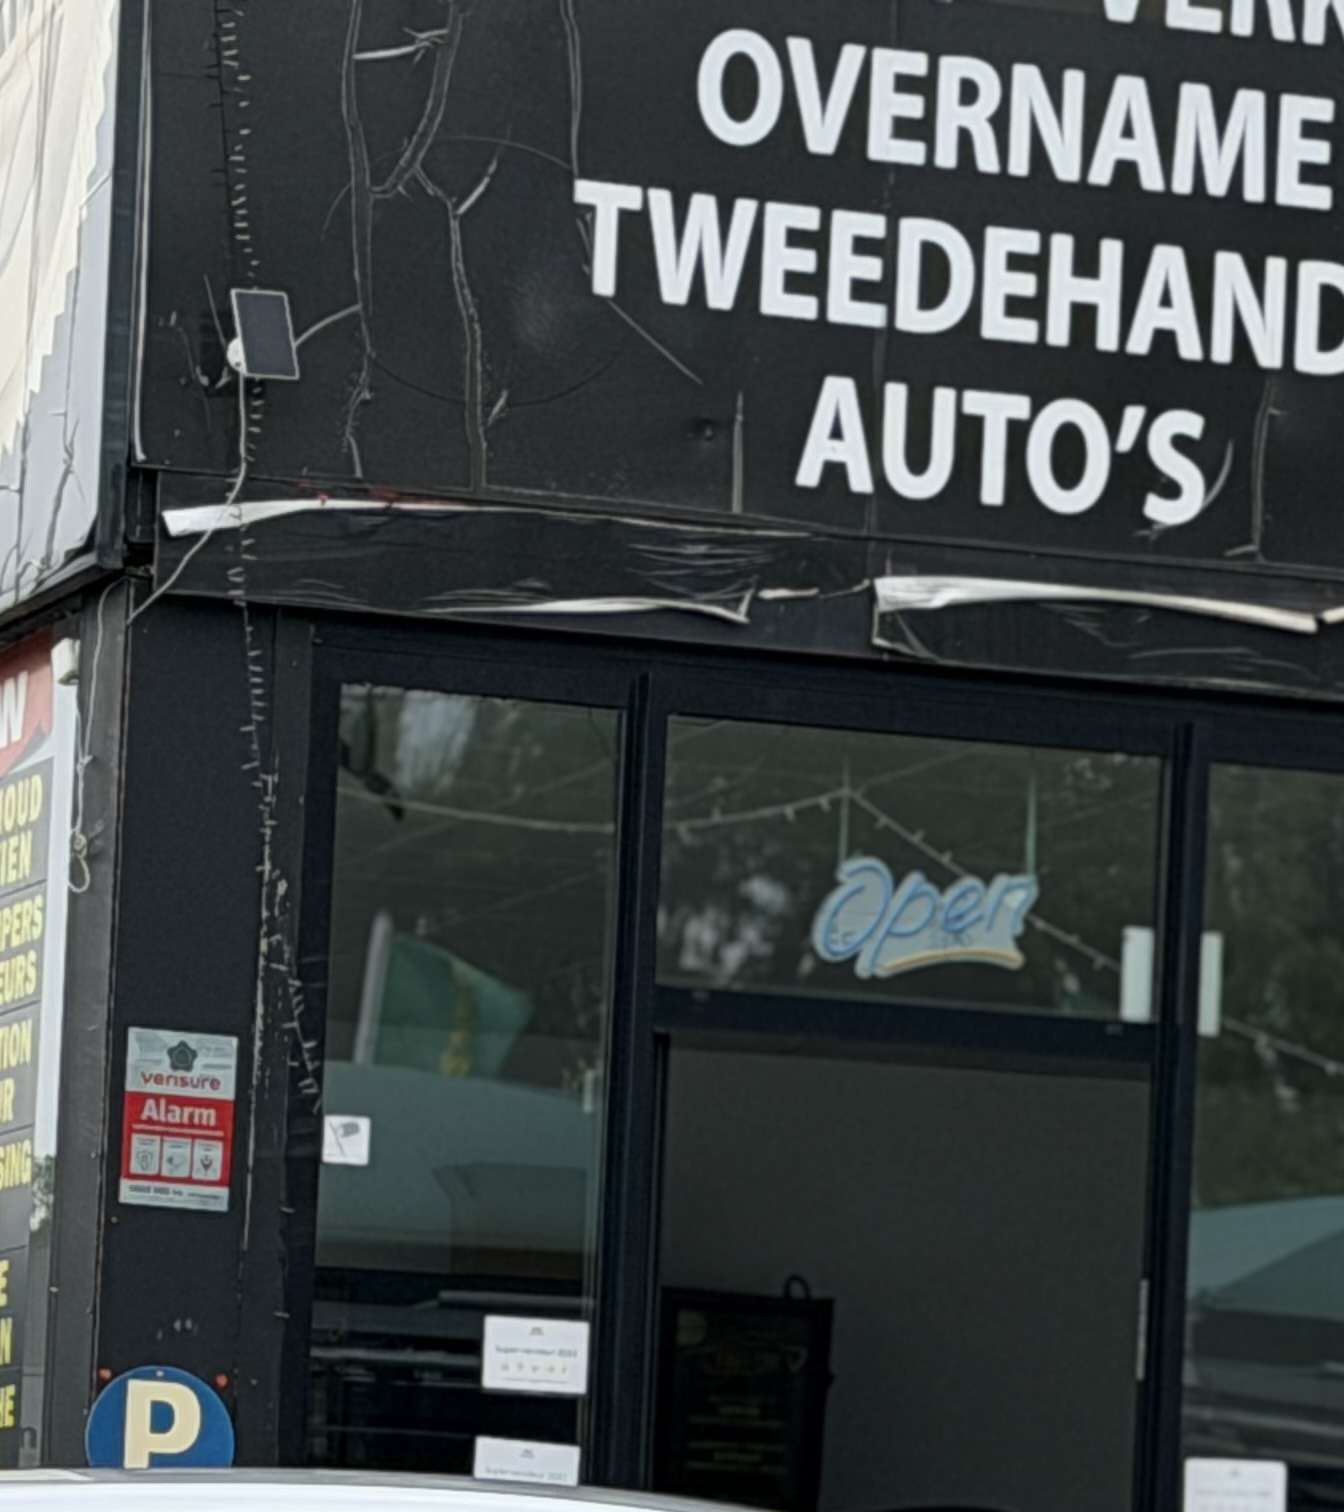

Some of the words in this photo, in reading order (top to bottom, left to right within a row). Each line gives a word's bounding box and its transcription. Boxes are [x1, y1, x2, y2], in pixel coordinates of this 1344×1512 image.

[697, 28, 1335, 211] OVERNAME
[794, 375, 1206, 526] AUTO'S
[814, 858, 1037, 977] Open
[141, 1071, 221, 1091] verisure
[141, 1098, 217, 1126] Alarm
[123, 1379, 202, 1470] P
